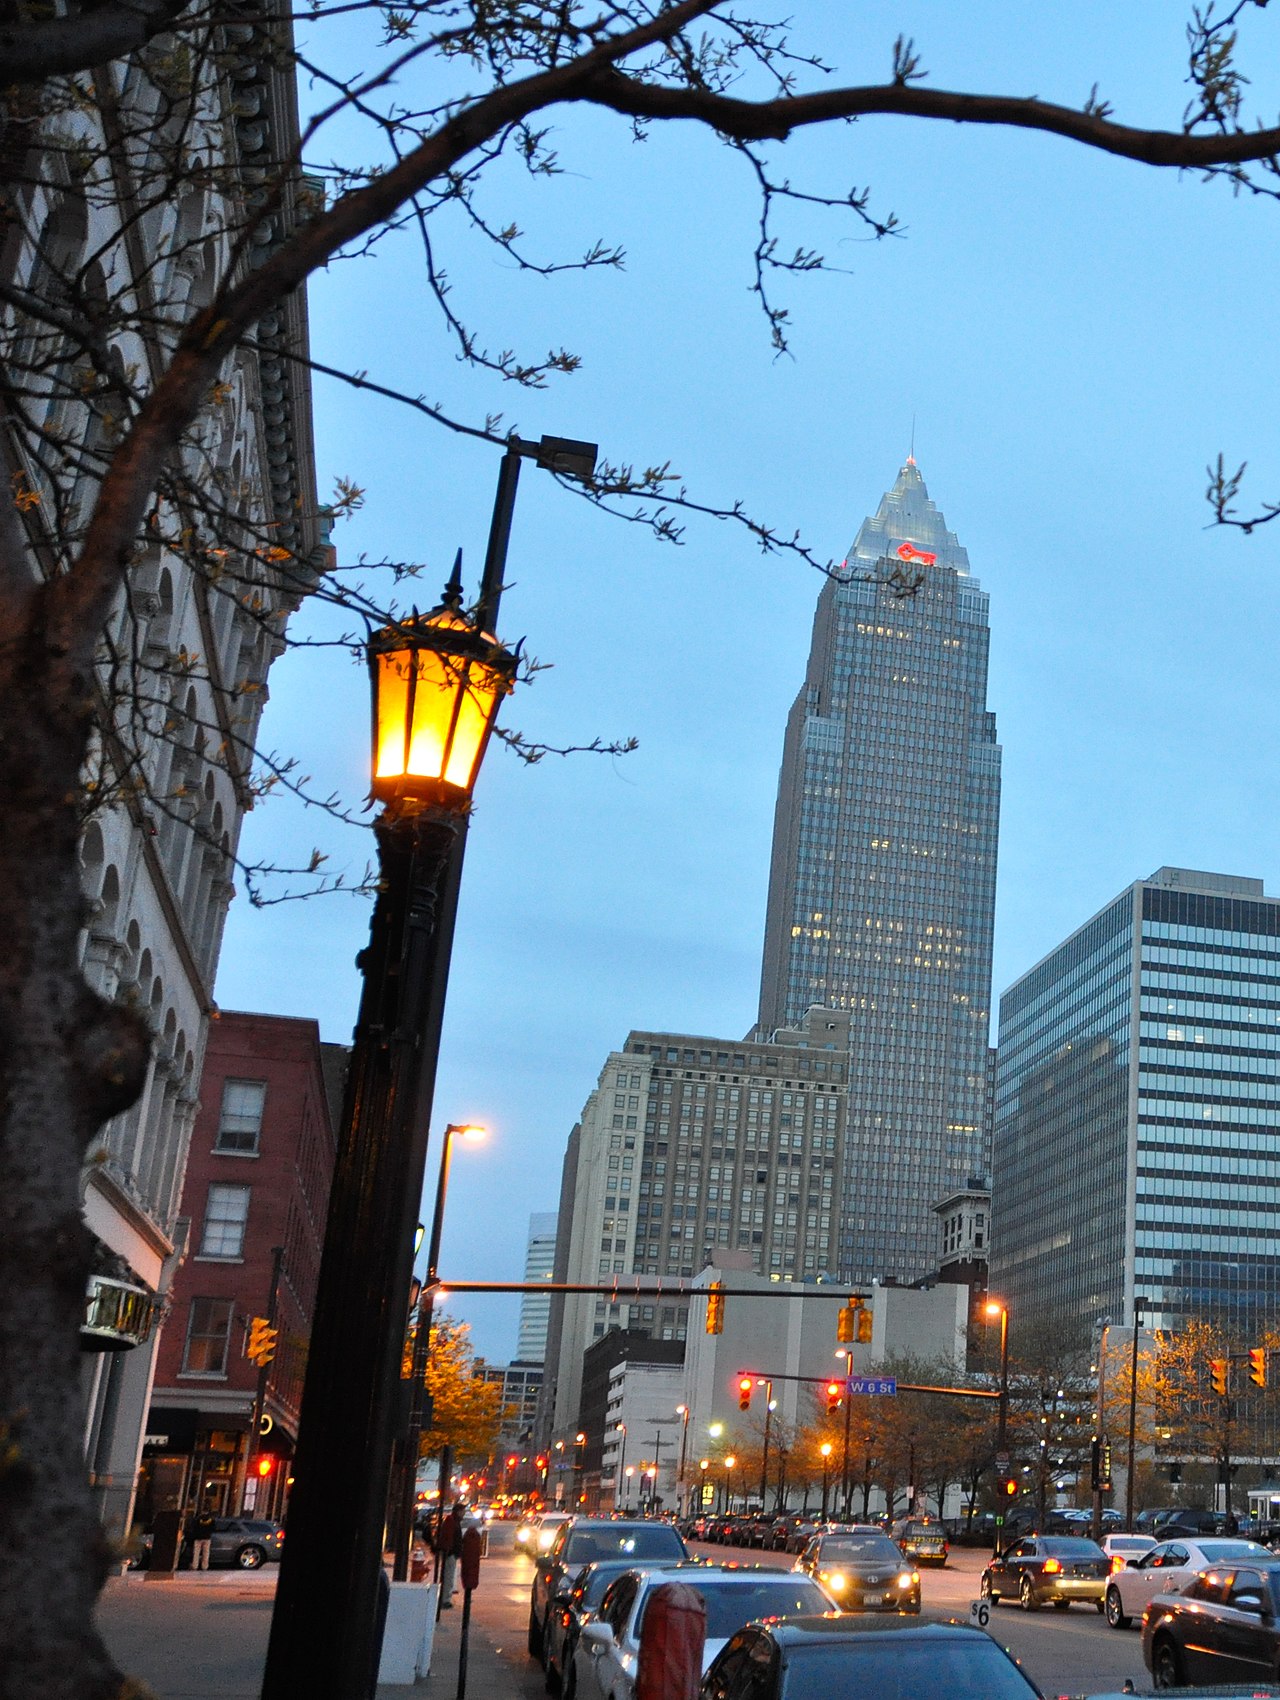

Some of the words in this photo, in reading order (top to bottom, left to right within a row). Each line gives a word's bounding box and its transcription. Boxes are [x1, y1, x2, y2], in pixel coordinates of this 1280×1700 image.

[850, 1382, 864, 1393] W
[867, 1382, 876, 1393] 6
[879, 1383, 892, 1394] St
[971, 1603, 990, 1627] $6
